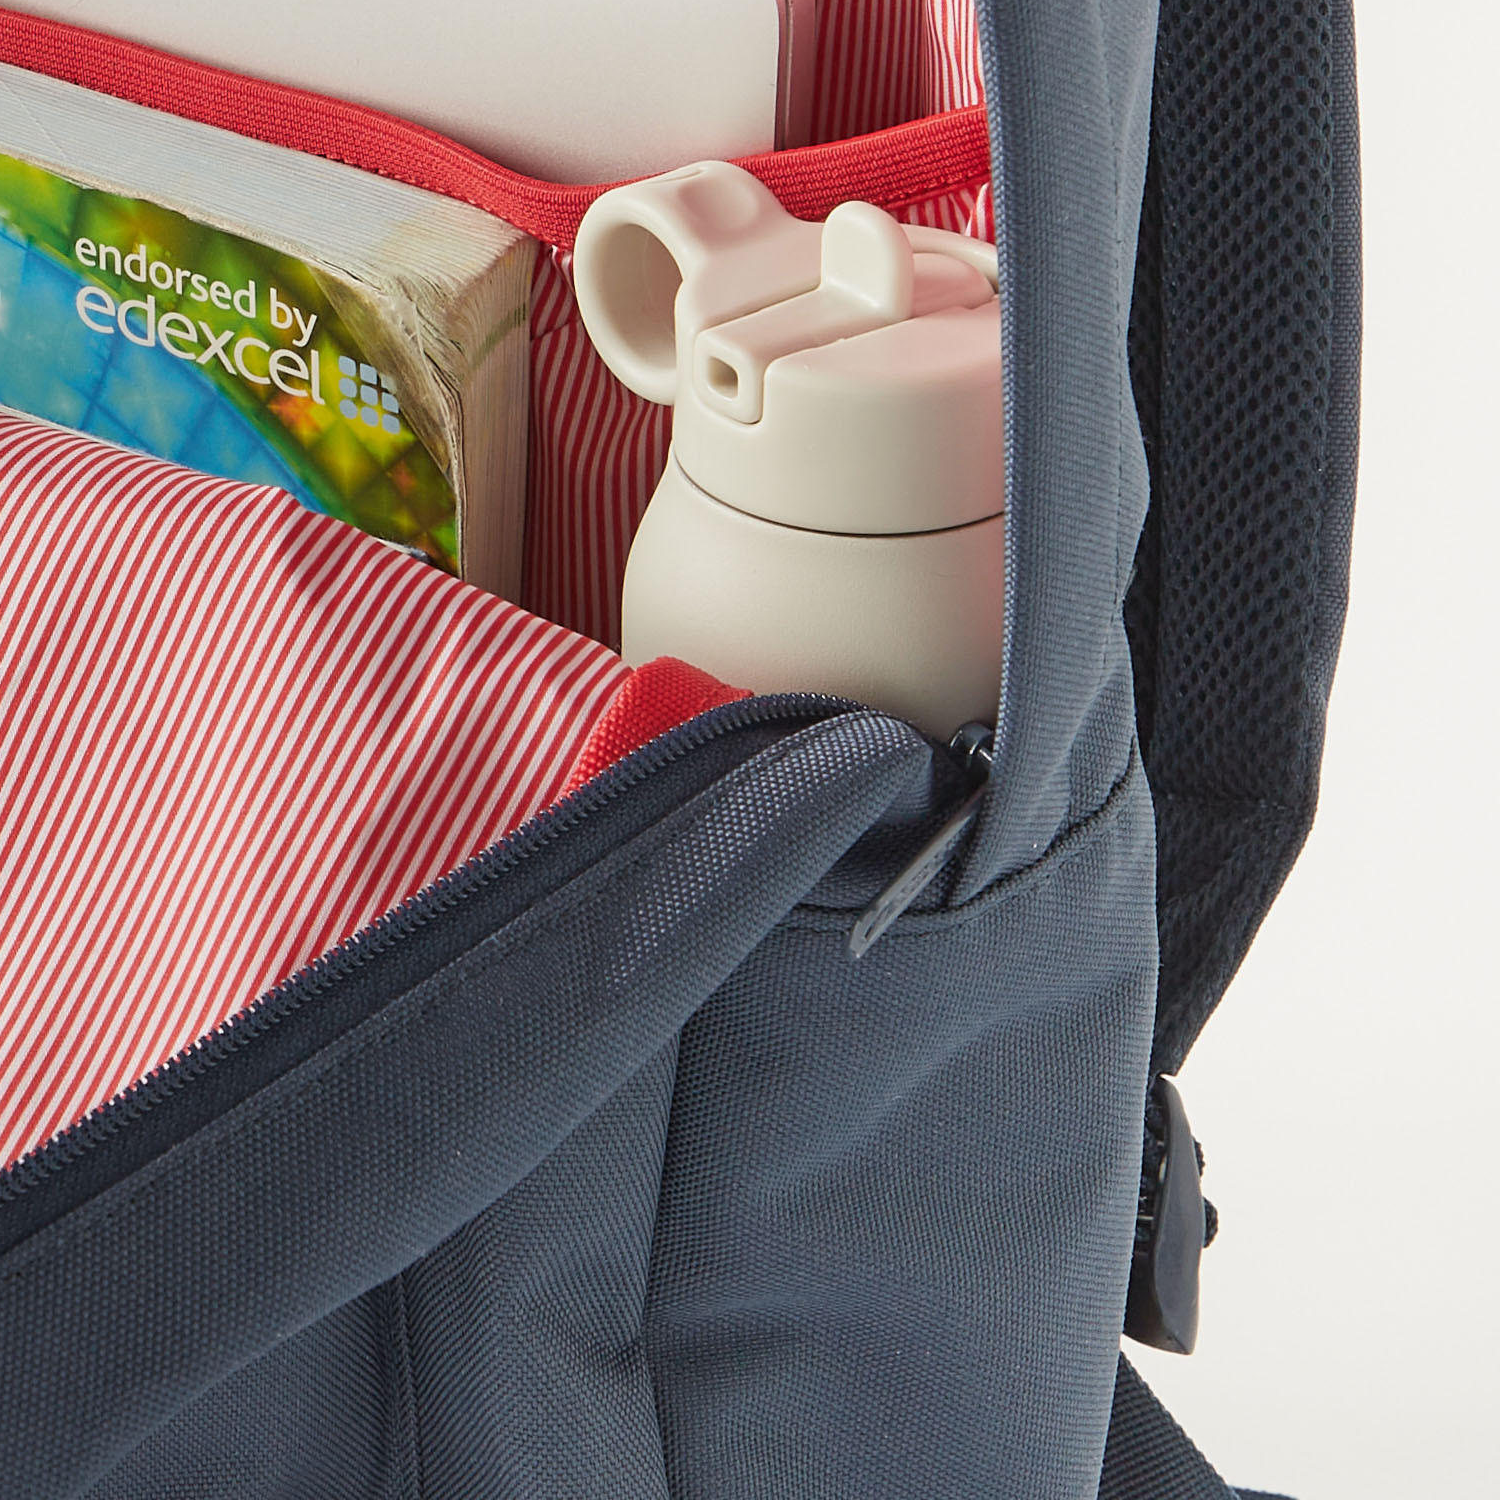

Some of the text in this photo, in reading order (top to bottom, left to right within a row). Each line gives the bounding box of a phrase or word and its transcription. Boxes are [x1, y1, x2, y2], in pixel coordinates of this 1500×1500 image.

[75, 237, 318, 348] endorsed by
[76, 285, 326, 405] edexcel
